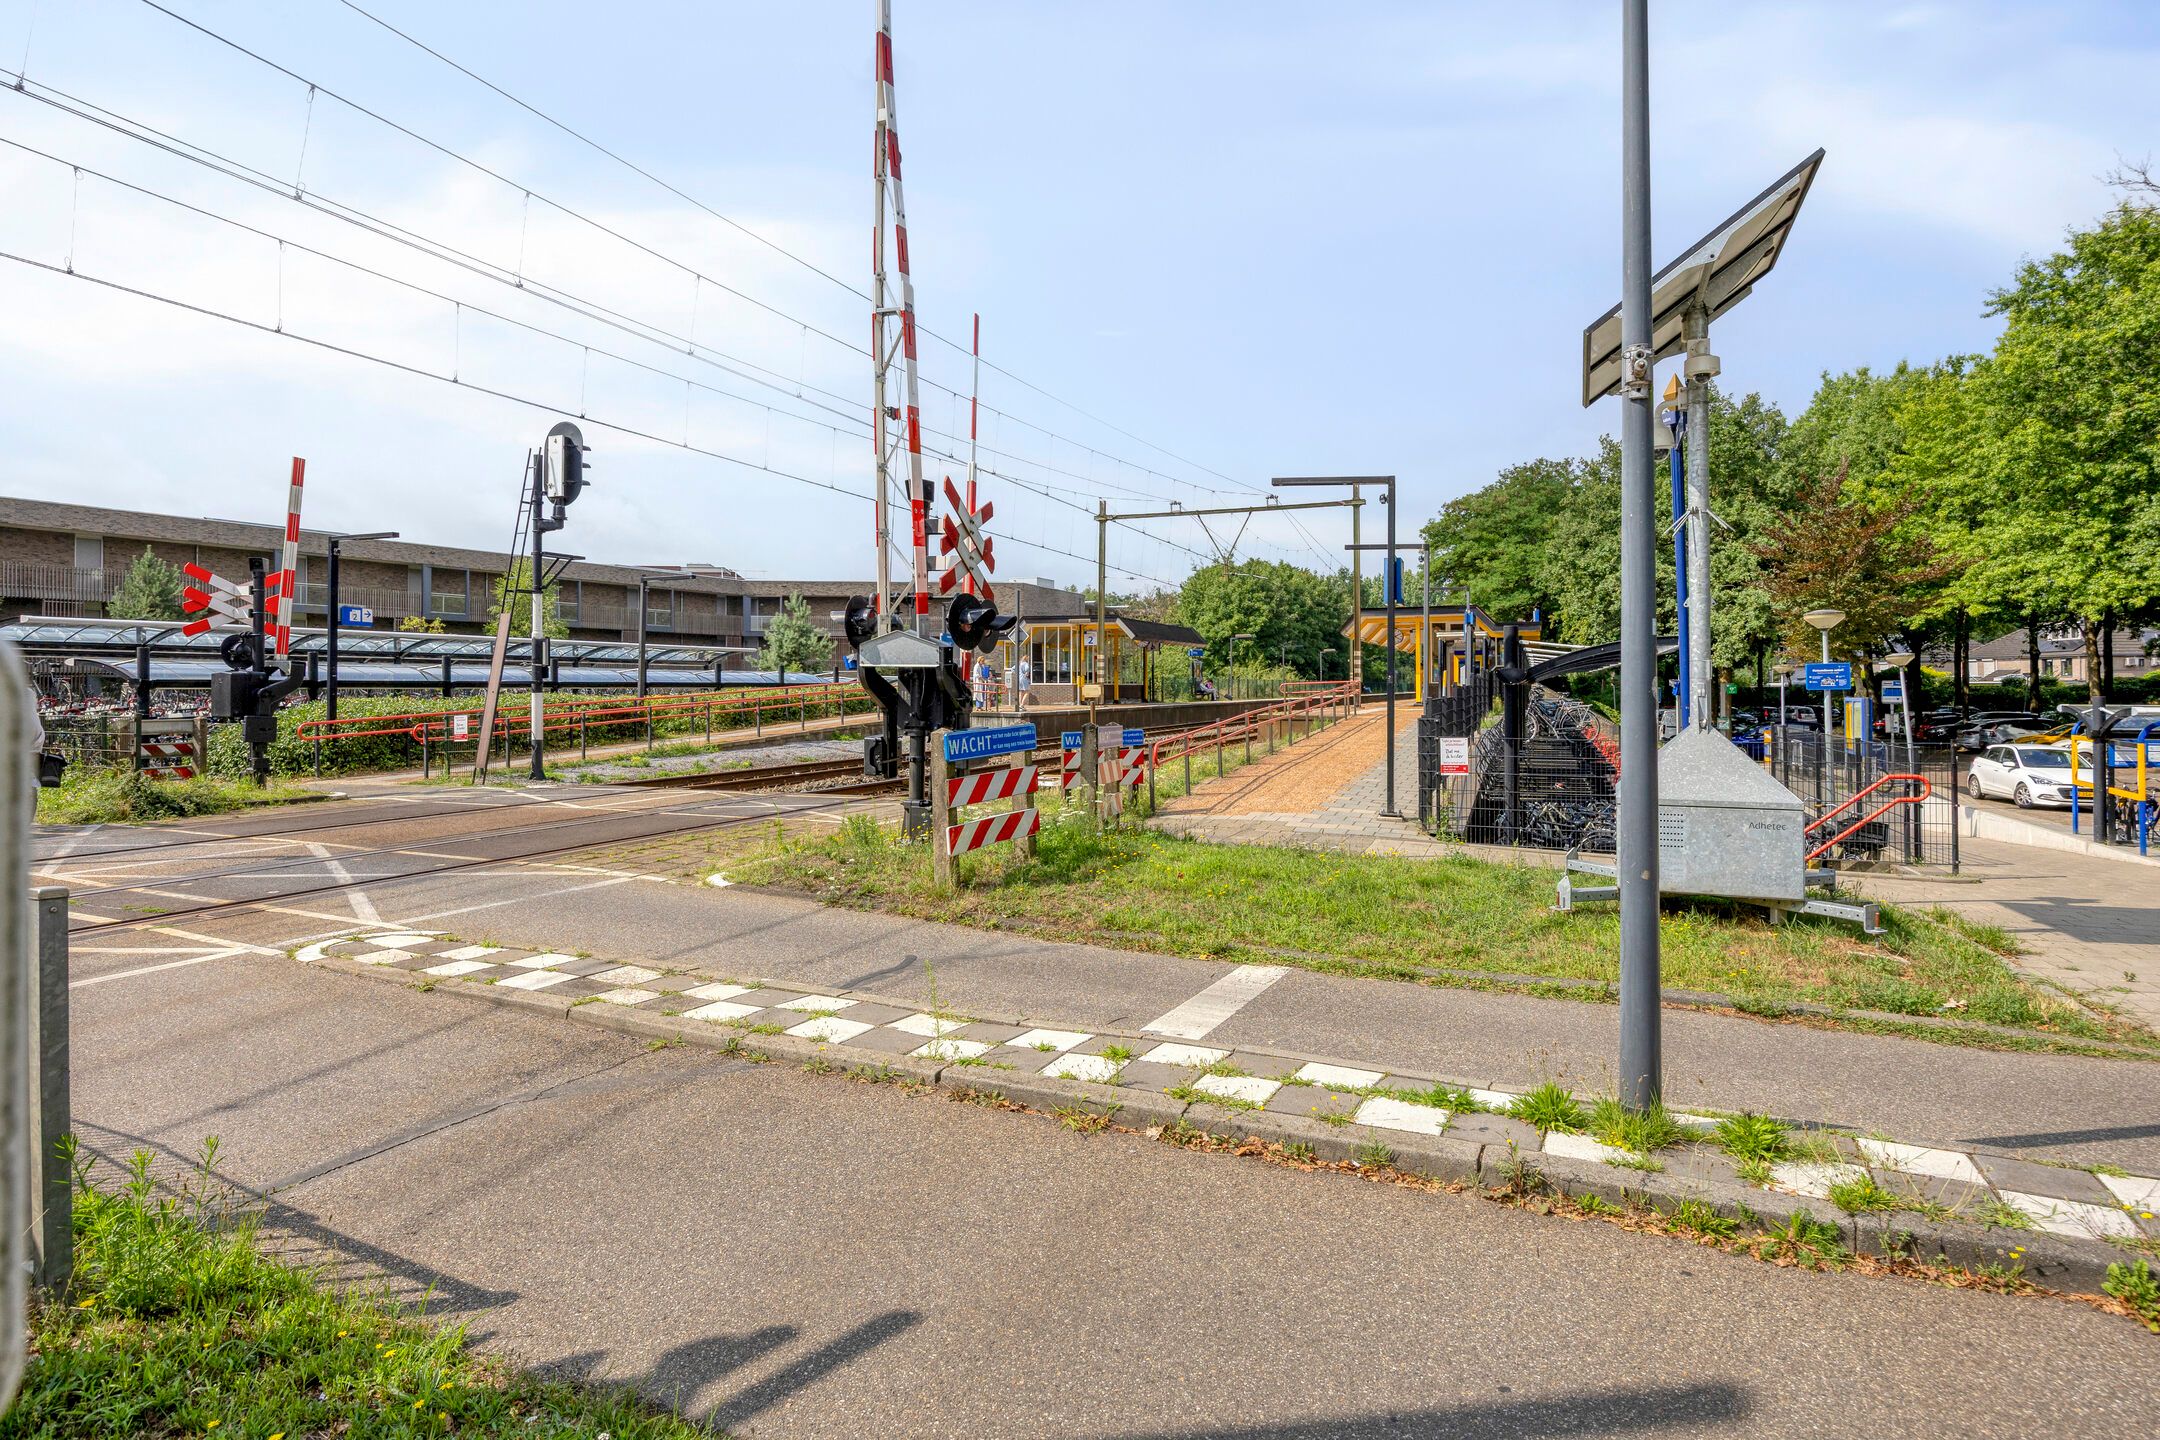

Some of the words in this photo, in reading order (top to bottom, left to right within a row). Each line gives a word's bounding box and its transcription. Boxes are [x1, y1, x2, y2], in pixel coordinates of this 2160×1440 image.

[1088, 636, 1094, 644] 2
[1065, 736, 1081, 745] WA
[948, 735, 992, 755] WACHT
[1749, 822, 1787, 830] Adhetec
